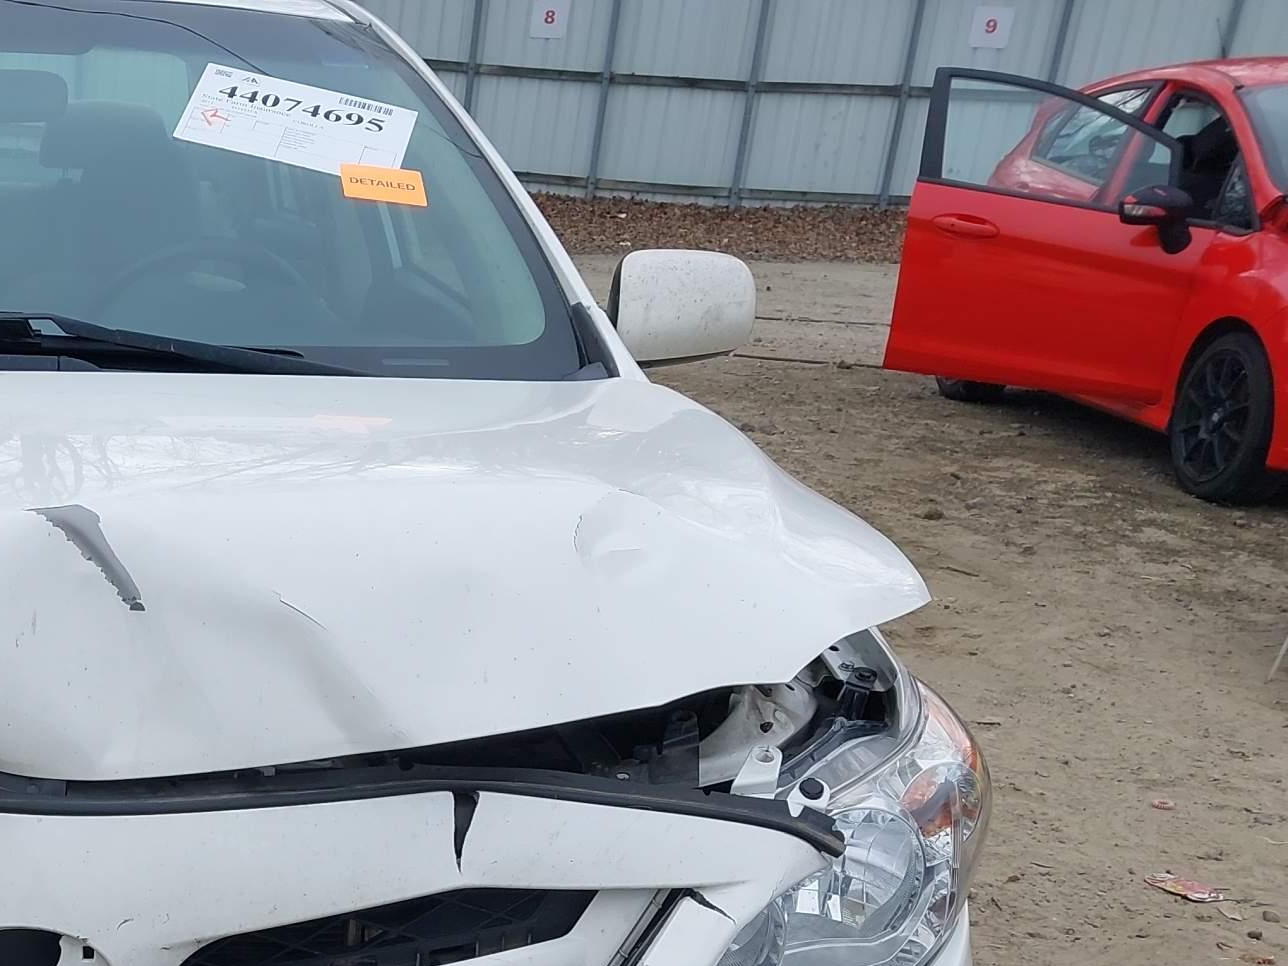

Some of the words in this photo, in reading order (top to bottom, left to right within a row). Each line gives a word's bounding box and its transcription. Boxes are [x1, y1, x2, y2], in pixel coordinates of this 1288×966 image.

[544, 10, 555, 24] 8
[985, 18, 998, 34] 9
[219, 85, 385, 133] 44074695
[349, 176, 416, 191] DETAILED
